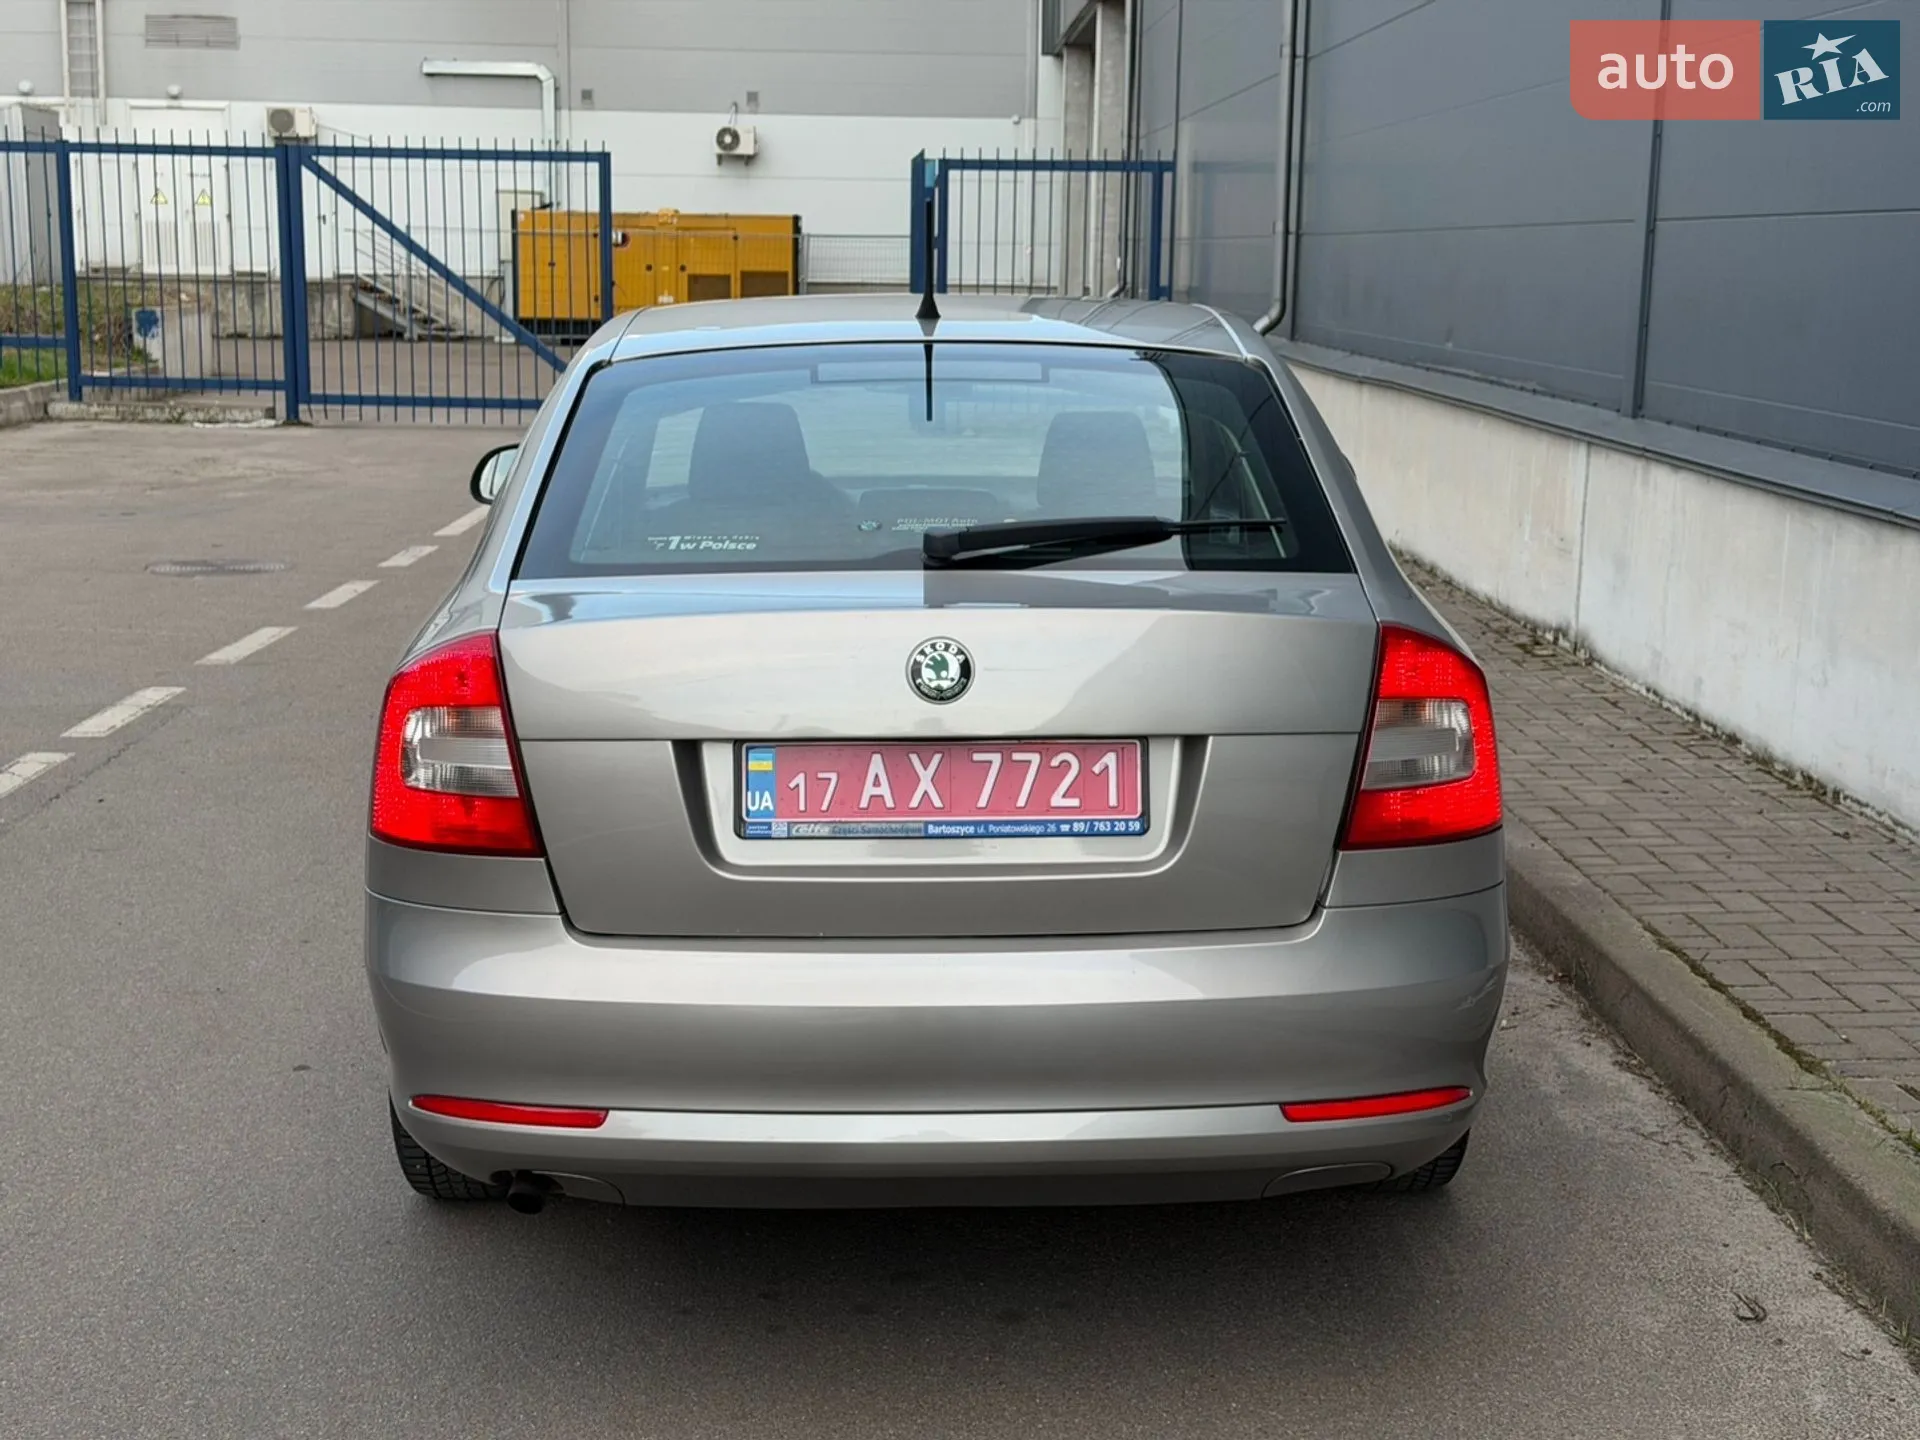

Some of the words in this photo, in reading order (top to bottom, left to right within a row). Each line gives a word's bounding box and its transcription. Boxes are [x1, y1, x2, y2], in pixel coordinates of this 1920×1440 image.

[699, 540, 757, 550] Polsce
[787, 772, 839, 811] 17
[858, 752, 944, 810] AX
[971, 751, 1120, 809] 7721
[747, 791, 774, 811] UA
[928, 824, 975, 836] Bartoszyce
[988, 824, 1045, 835] Poniatowskiego
[1046, 823, 1057, 832] 26
[1093, 821, 1111, 832] 763
[1113, 821, 1126, 831] 20
[1127, 821, 1140, 831] 59
